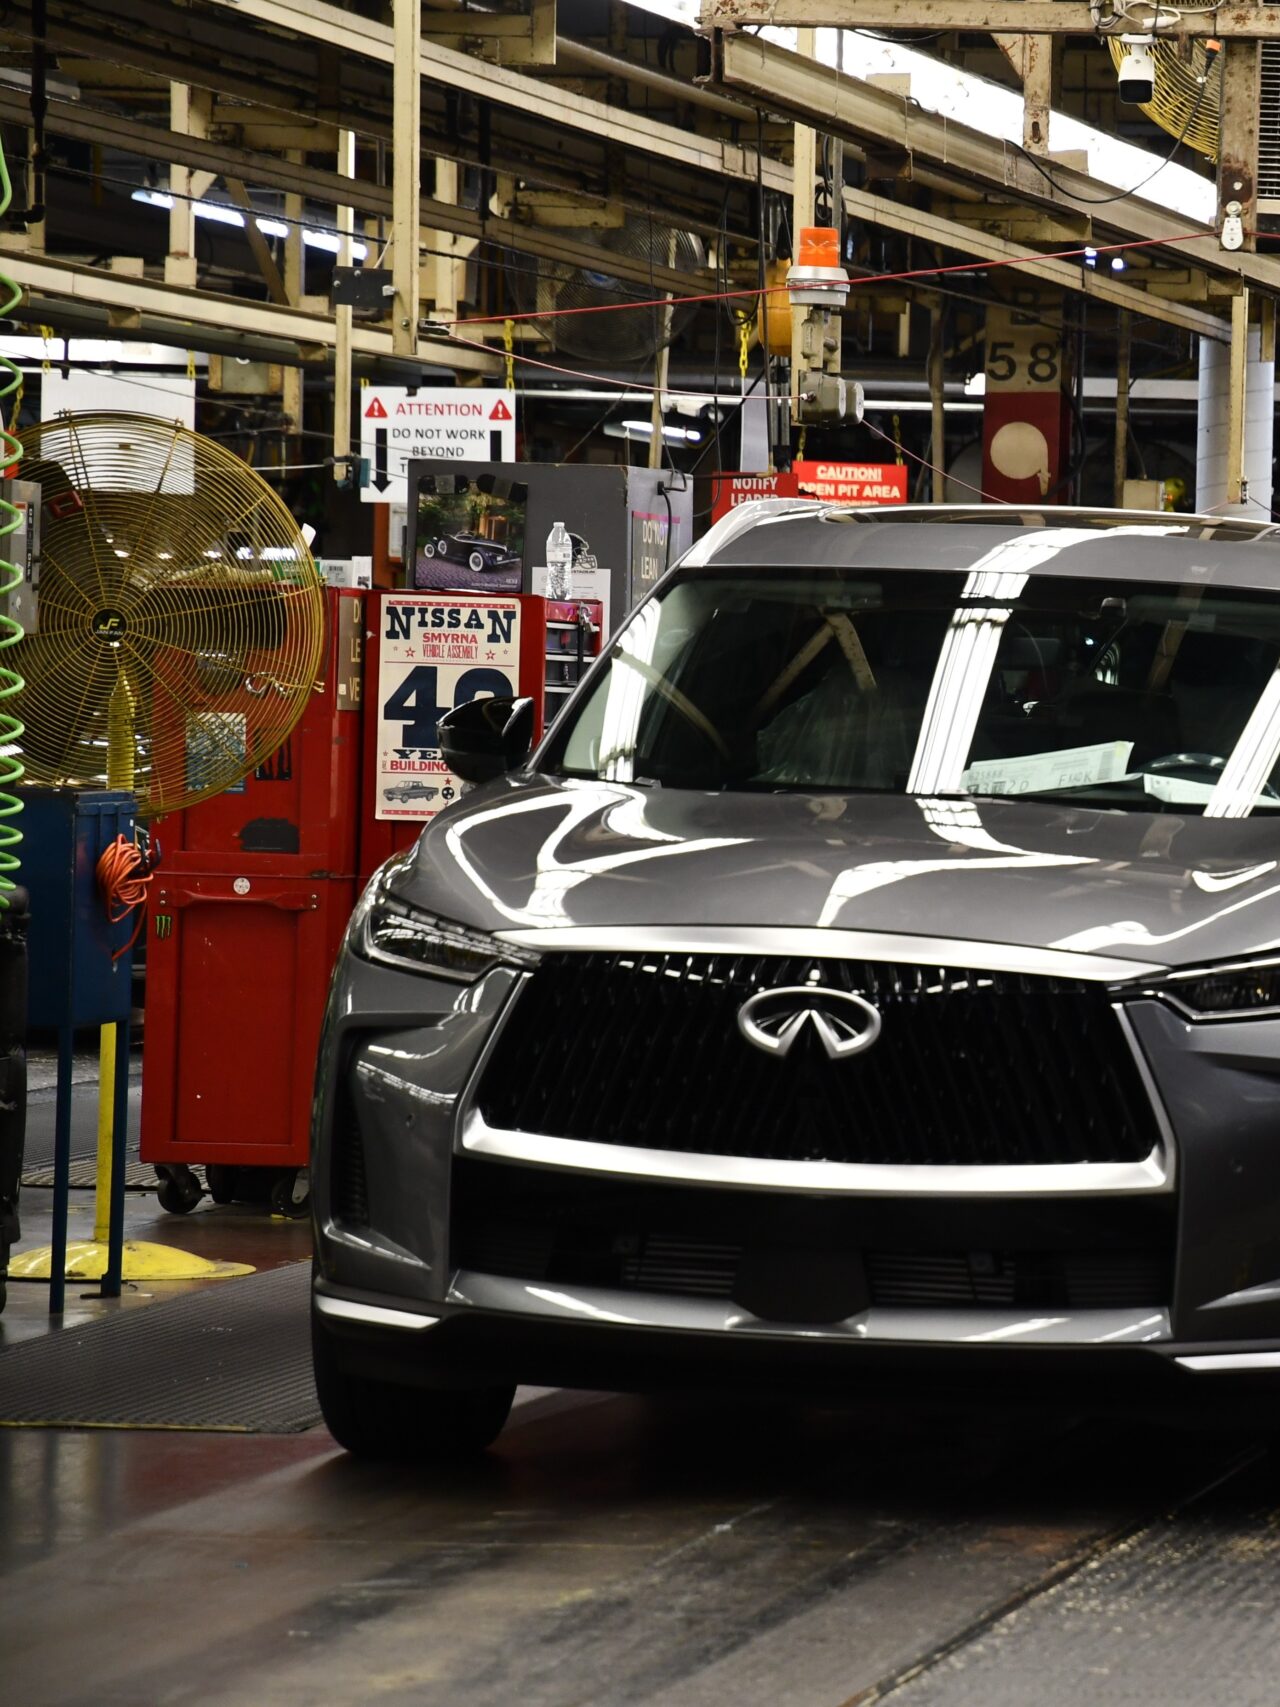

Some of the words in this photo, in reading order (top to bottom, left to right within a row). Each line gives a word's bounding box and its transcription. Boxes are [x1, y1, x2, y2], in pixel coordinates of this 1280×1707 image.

[987, 341, 1057, 383] 58
[396, 403, 483, 417] ATTENTION
[392, 428, 411, 439] DO
[415, 428, 442, 440] NOT
[446, 429, 486, 441] WORK
[412, 446, 465, 457] BEYOND
[816, 465, 882, 481] CAUTION!
[732, 476, 778, 490] NOTIFY
[838, 484, 860, 497] PIT
[862, 485, 901, 499] AREA
[642, 520, 653, 544] DO
[641, 556, 658, 581] LEAN
[385, 606, 517, 644] NISSAN
[422, 632, 479, 644] SMYRNA
[422, 644, 445, 659] VEHICLE
[446, 645, 479, 660] ASSEMBLY
[390, 760, 449, 772] BUILDING
